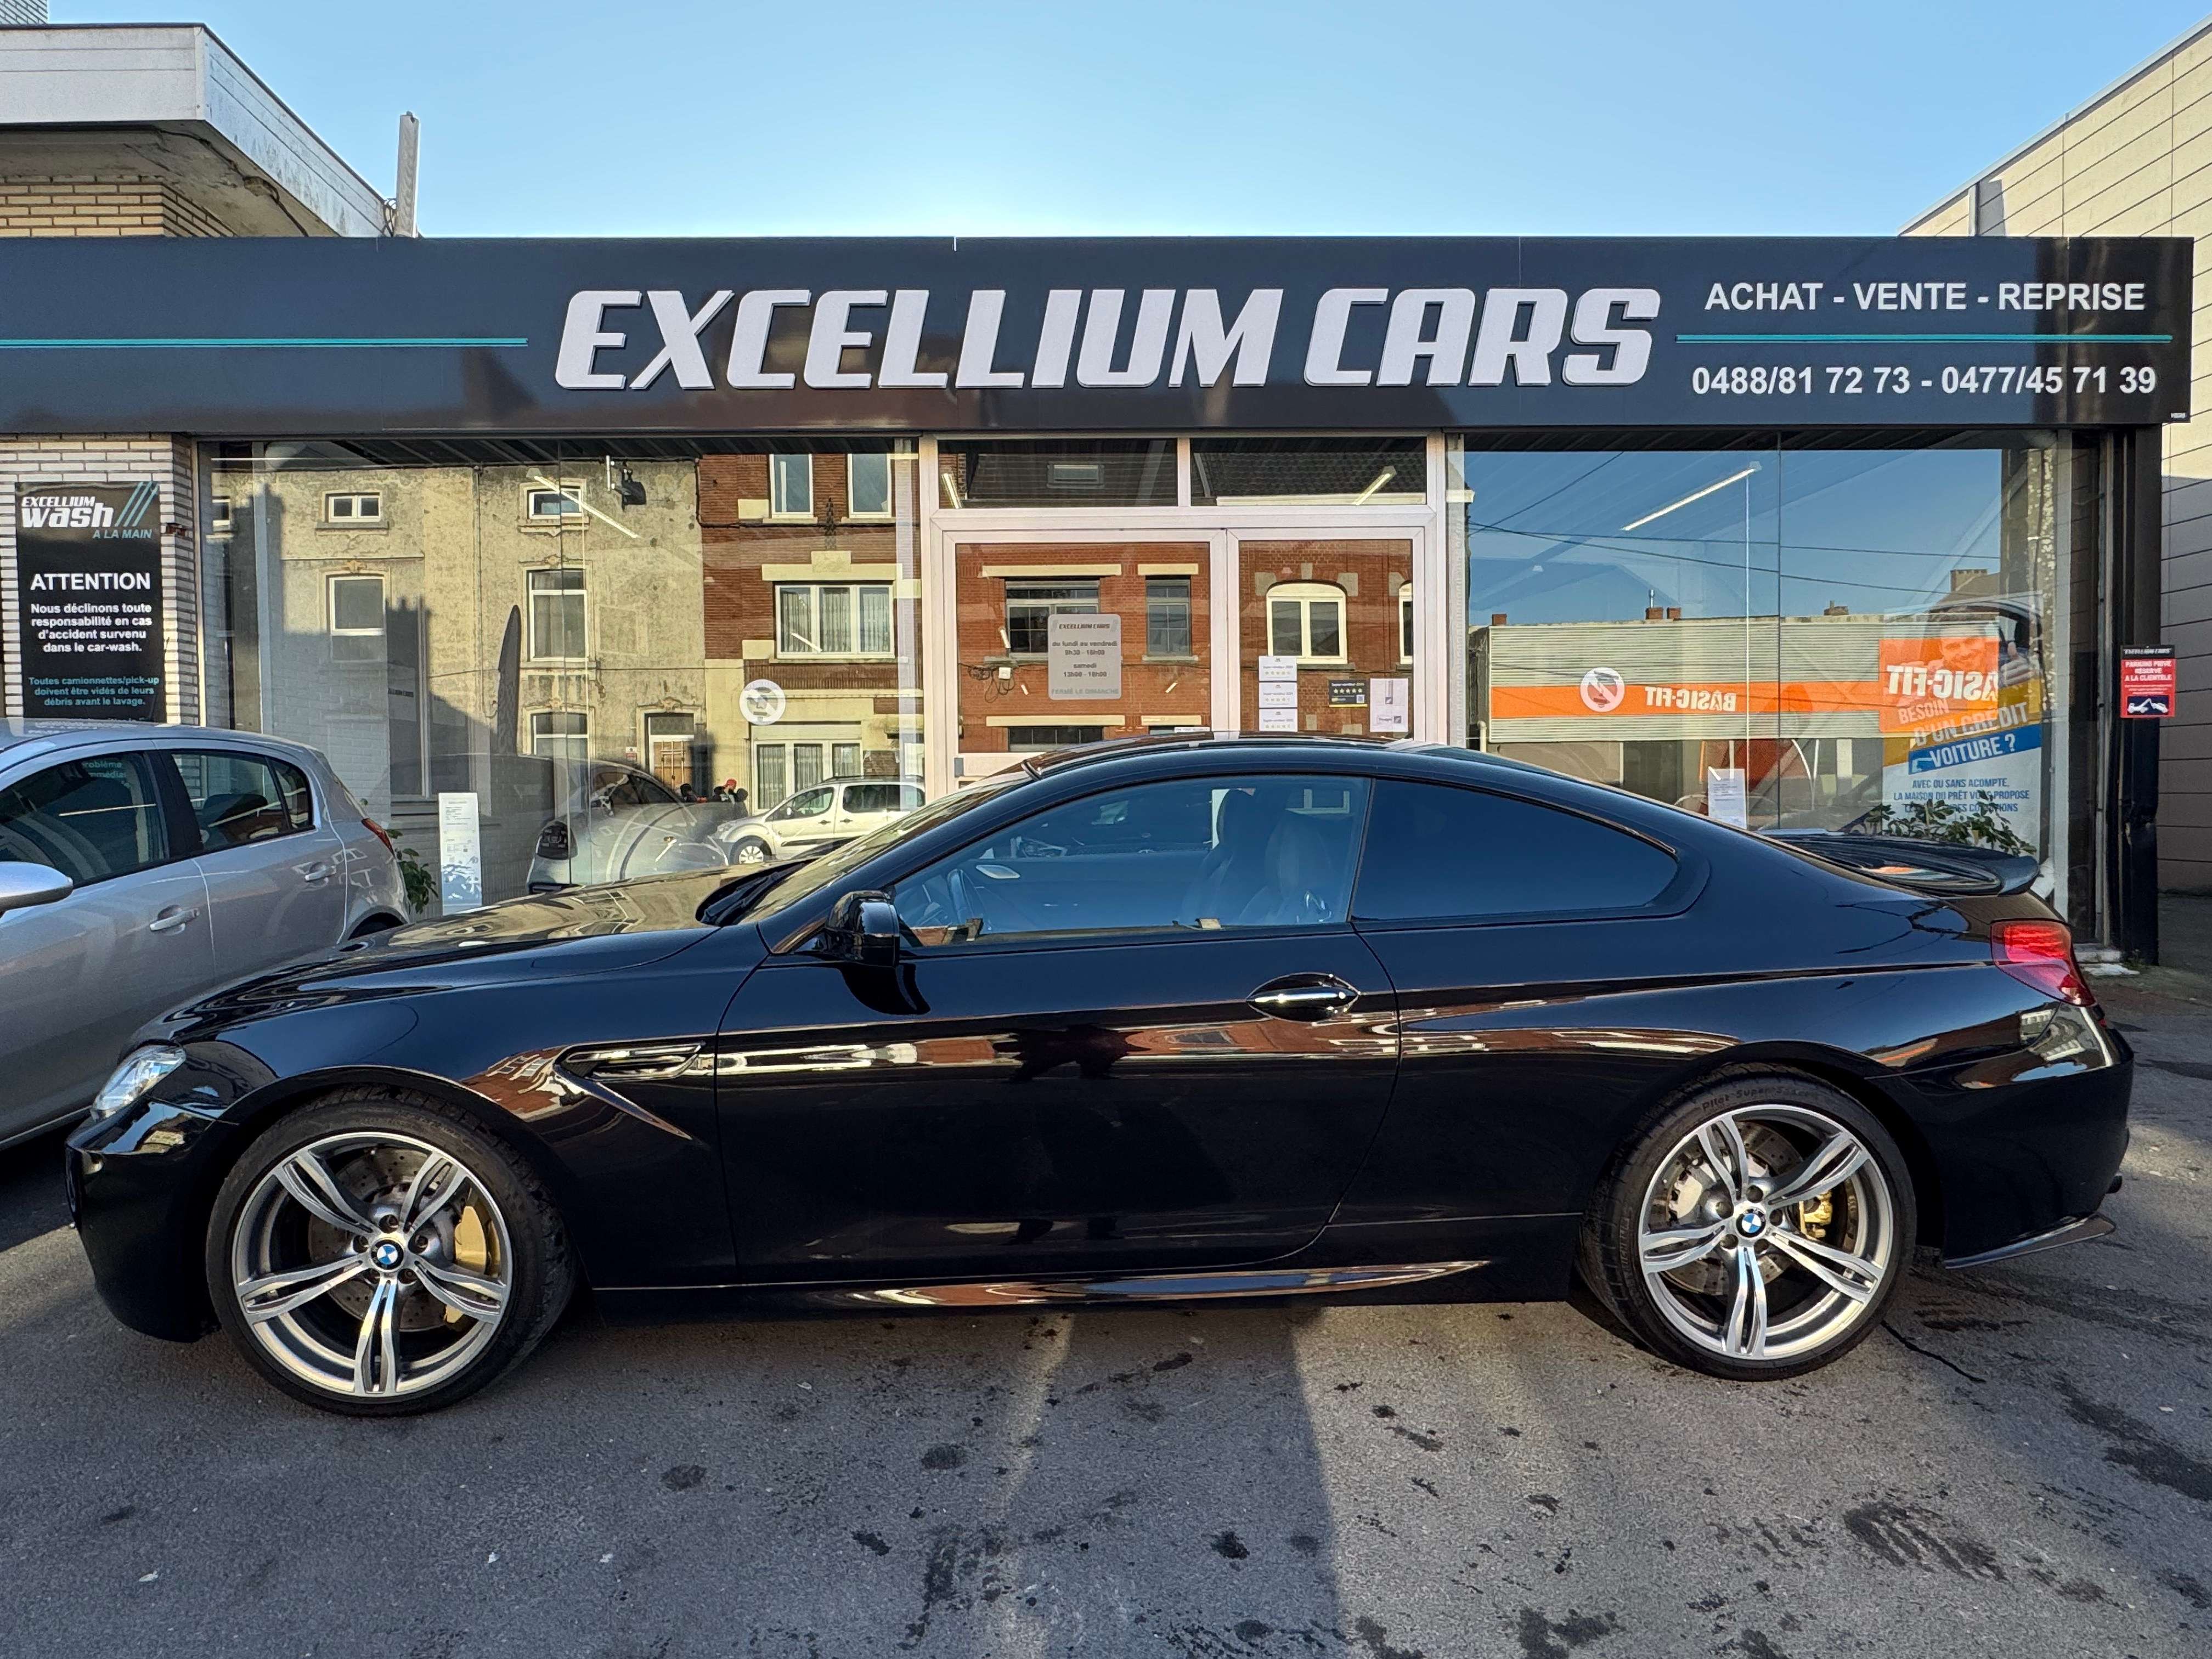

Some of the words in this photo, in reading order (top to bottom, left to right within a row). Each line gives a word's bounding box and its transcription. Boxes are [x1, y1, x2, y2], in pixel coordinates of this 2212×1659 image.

[1705, 282, 1824, 311] ACHAT
[1853, 282, 1967, 311] VENTE
[1997, 282, 2146, 311] REPRISE
[554, 290, 1284, 391] EXCELLIUM
[1304, 287, 1661, 387] CARS
[1692, 365, 1813, 395] 0488/81
[1825, 366, 1864, 394] 72
[1872, 366, 1911, 394] 73
[1941, 365, 2063, 394] 0477/45
[2073, 366, 2106, 393] 71
[2119, 365, 2157, 394] 39
[21, 496, 95, 507] EXCELLIUM
[92, 530, 101, 539] A
[103, 529, 119, 539] LA
[122, 529, 153, 539] MAIN
[30, 572, 151, 590] ATTENTION
[31, 603, 61, 613] Nous
[64, 603, 119, 613] déclinons
[122, 603, 152, 613] toute
[31, 616, 112, 628] responsabilité
[115, 618, 129, 626] en
[132, 617, 153, 626] cas
[38, 629, 98, 640] d'accident
[99, 630, 146, 639] survenu
[43, 642, 71, 652] dans
[74, 642, 84, 652] le
[87, 642, 143, 652] car-wash.
[29, 677, 59, 685] Toutes
[61, 676, 159, 686] camionnettes/pick-up
[34, 687, 69, 696] doivent
[71, 687, 89, 695] être
[91, 686, 115, 695] vidés
[117, 686, 129, 695] de
[131, 686, 155, 695] leurs
[44, 698, 73, 706] débris
[103, 697, 111, 706] le
[113, 697, 145, 707] lavage.
[1898, 698, 1949, 725] BESOIN
[1929, 736, 2003, 768] VOITURE
[2005, 733, 2016, 752] ?
[1912, 780, 1932, 788] AVEC
[1933, 779, 1944, 788] OU
[1945, 778, 1966, 788] SANS
[1894, 792, 1903, 800] LA
[1905, 791, 1933, 800] MAISON
[1936, 791, 1946, 800] DU
[1948, 789, 1967, 800] PRÊT
[1970, 791, 1991, 799] VOS
[1993, 790, 2030, 799] PROPOSE
